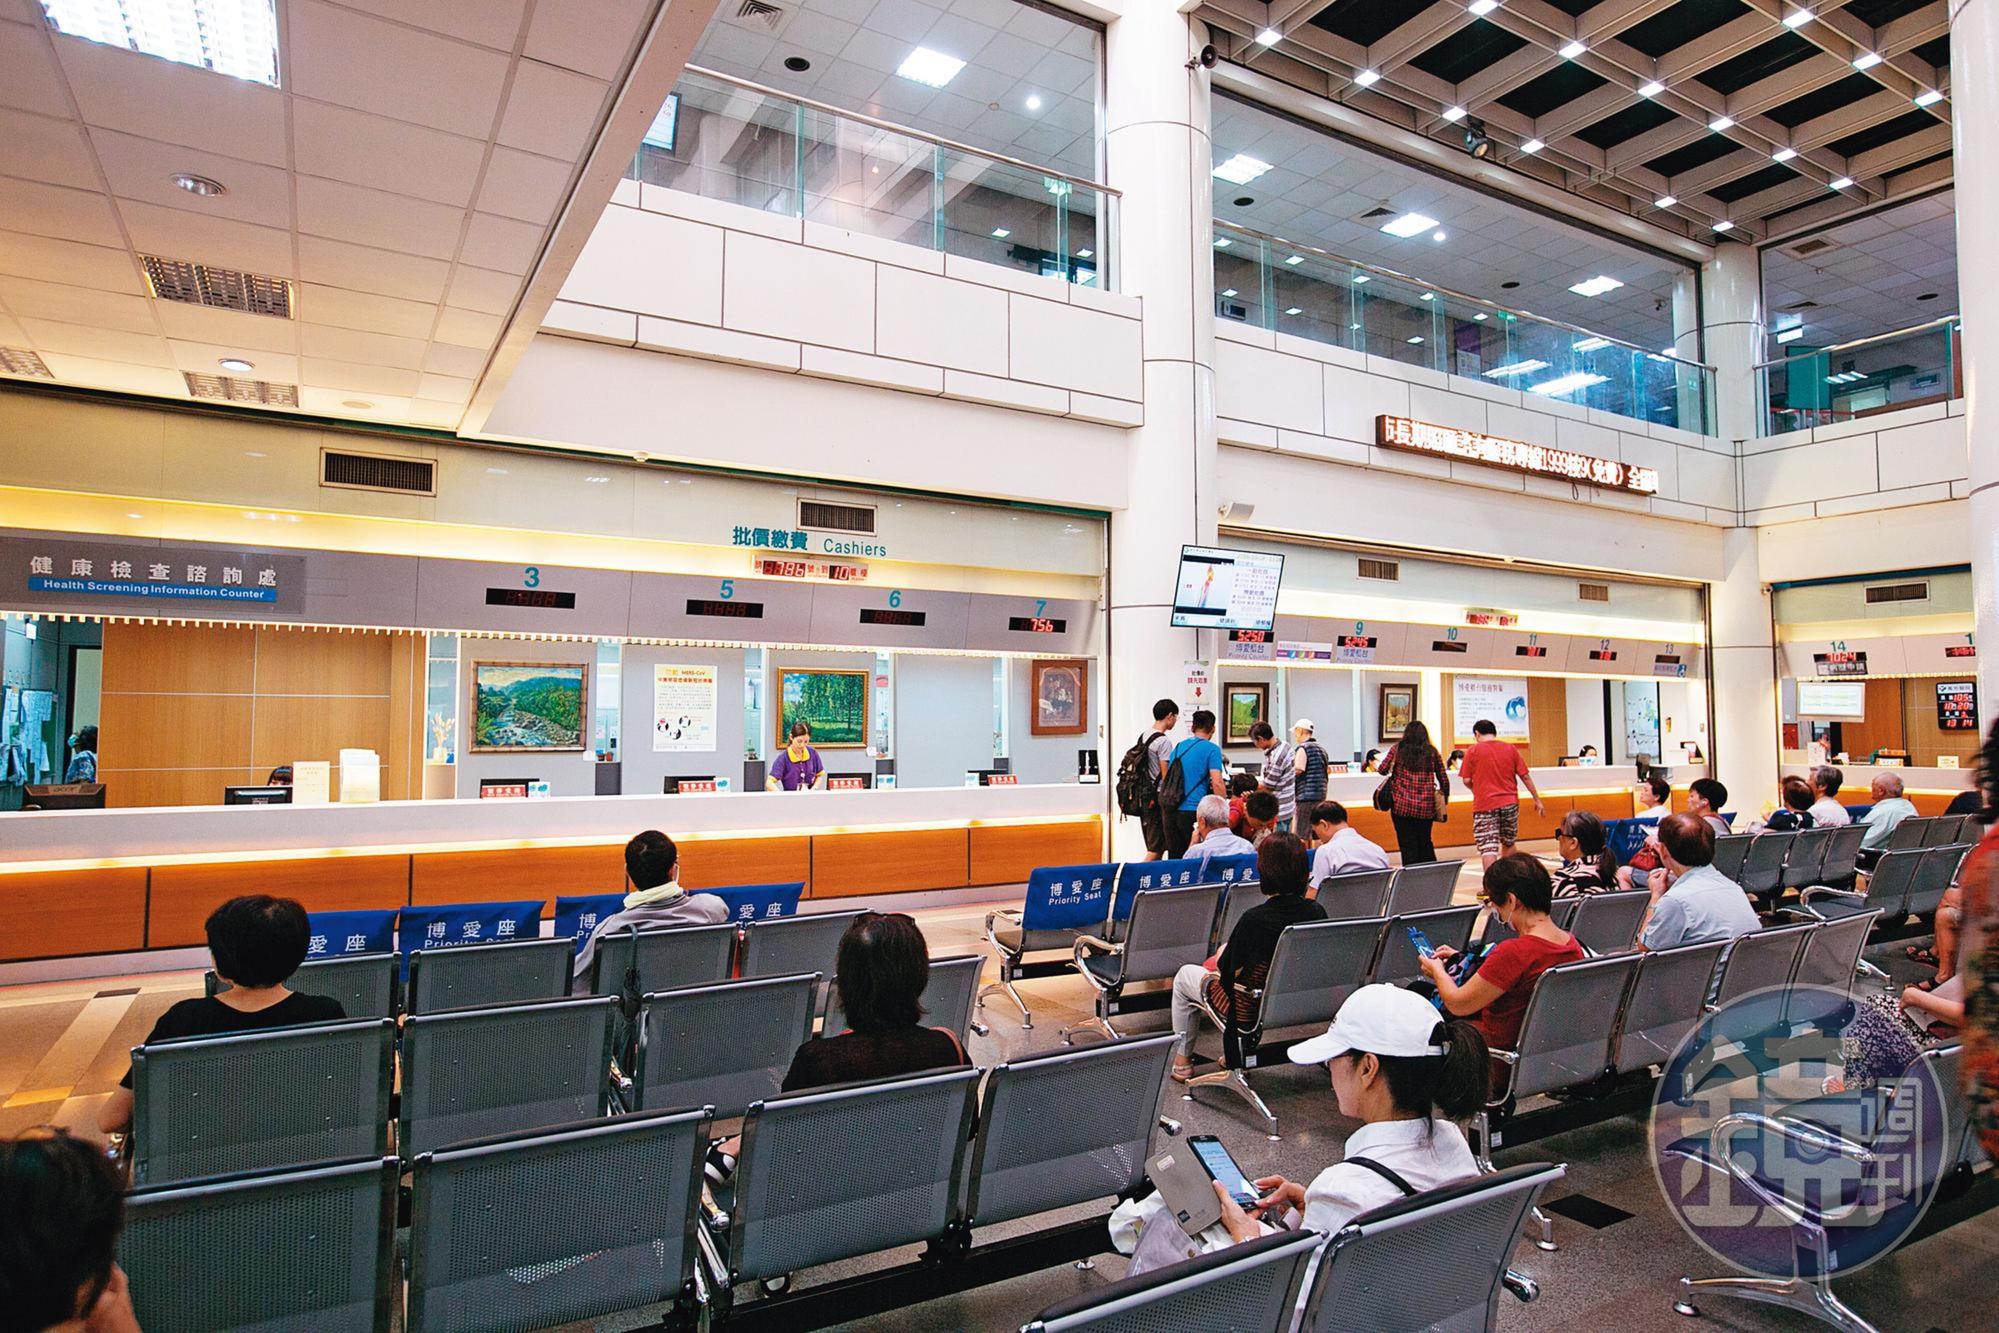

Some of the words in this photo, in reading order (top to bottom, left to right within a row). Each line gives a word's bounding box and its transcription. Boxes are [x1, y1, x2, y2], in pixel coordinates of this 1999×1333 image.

[732, 526, 808, 551] 批價繳費
[823, 538, 887, 557] Cashiers
[30, 556, 277, 587] 健康檢查諮詢處
[524, 566, 540, 588] 3
[834, 567, 850, 579] 10
[44, 579, 84, 590] Health
[87, 581, 149, 594] Screening
[150, 585, 217, 597] Information
[220, 588, 264, 598] Counter
[720, 579, 734, 599] 5
[889, 590, 901, 608] 6
[1035, 600, 1047, 617] 7
[1030, 618, 1053, 632] 756
[1355, 621, 1364, 636] 9
[1237, 630, 1265, 642] 5250
[1447, 628, 1457, 641] 10
[1529, 633, 1537, 646] 11
[1600, 639, 1610, 650] 12
[1665, 644, 1674, 654] 13
[1830, 641, 1846, 651] 14
[1139, 871, 1190, 889] 博愛座
[1222, 867, 1254, 882] 博愛
[1050, 878, 1103, 896] 博愛座
[1048, 895, 1081, 906] Priority
[1084, 891, 1102, 902] Seat
[739, 902, 783, 919] 愛座
[426, 919, 516, 939] 博愛座
[308, 933, 367, 954] 愛座
